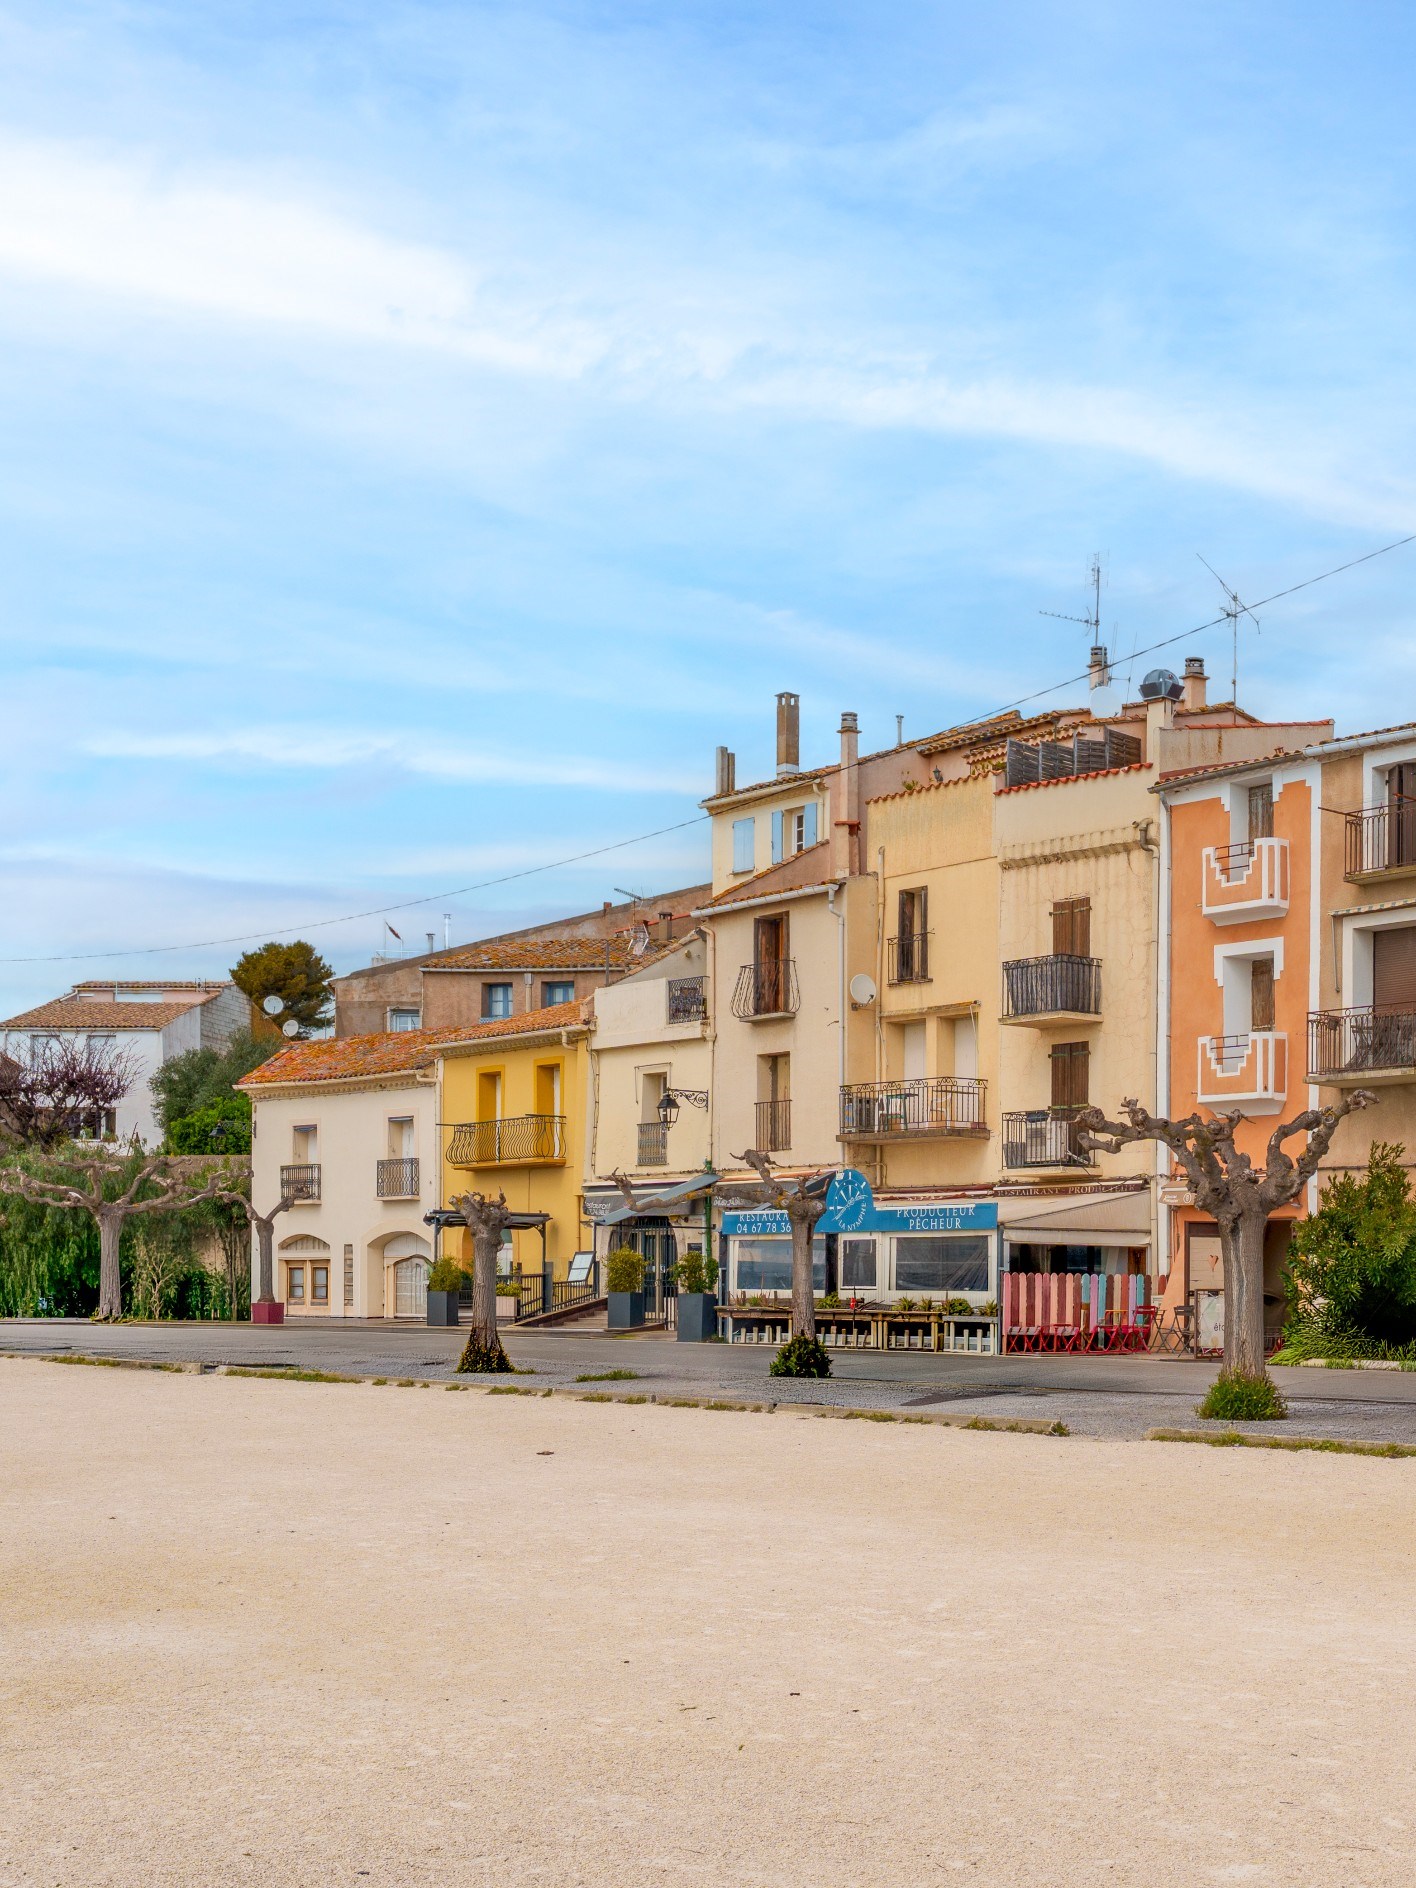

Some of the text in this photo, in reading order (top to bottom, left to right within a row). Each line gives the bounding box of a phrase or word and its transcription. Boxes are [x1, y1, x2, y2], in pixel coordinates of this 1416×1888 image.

[739, 1213, 789, 1222] RESTAURA
[838, 1202, 867, 1231] LA NYMPHE
[896, 1206, 975, 1218] PRODUCTEUR
[736, 1222, 792, 1233] 04 67 78 36
[909, 1217, 962, 1230] PÊCHEUR
